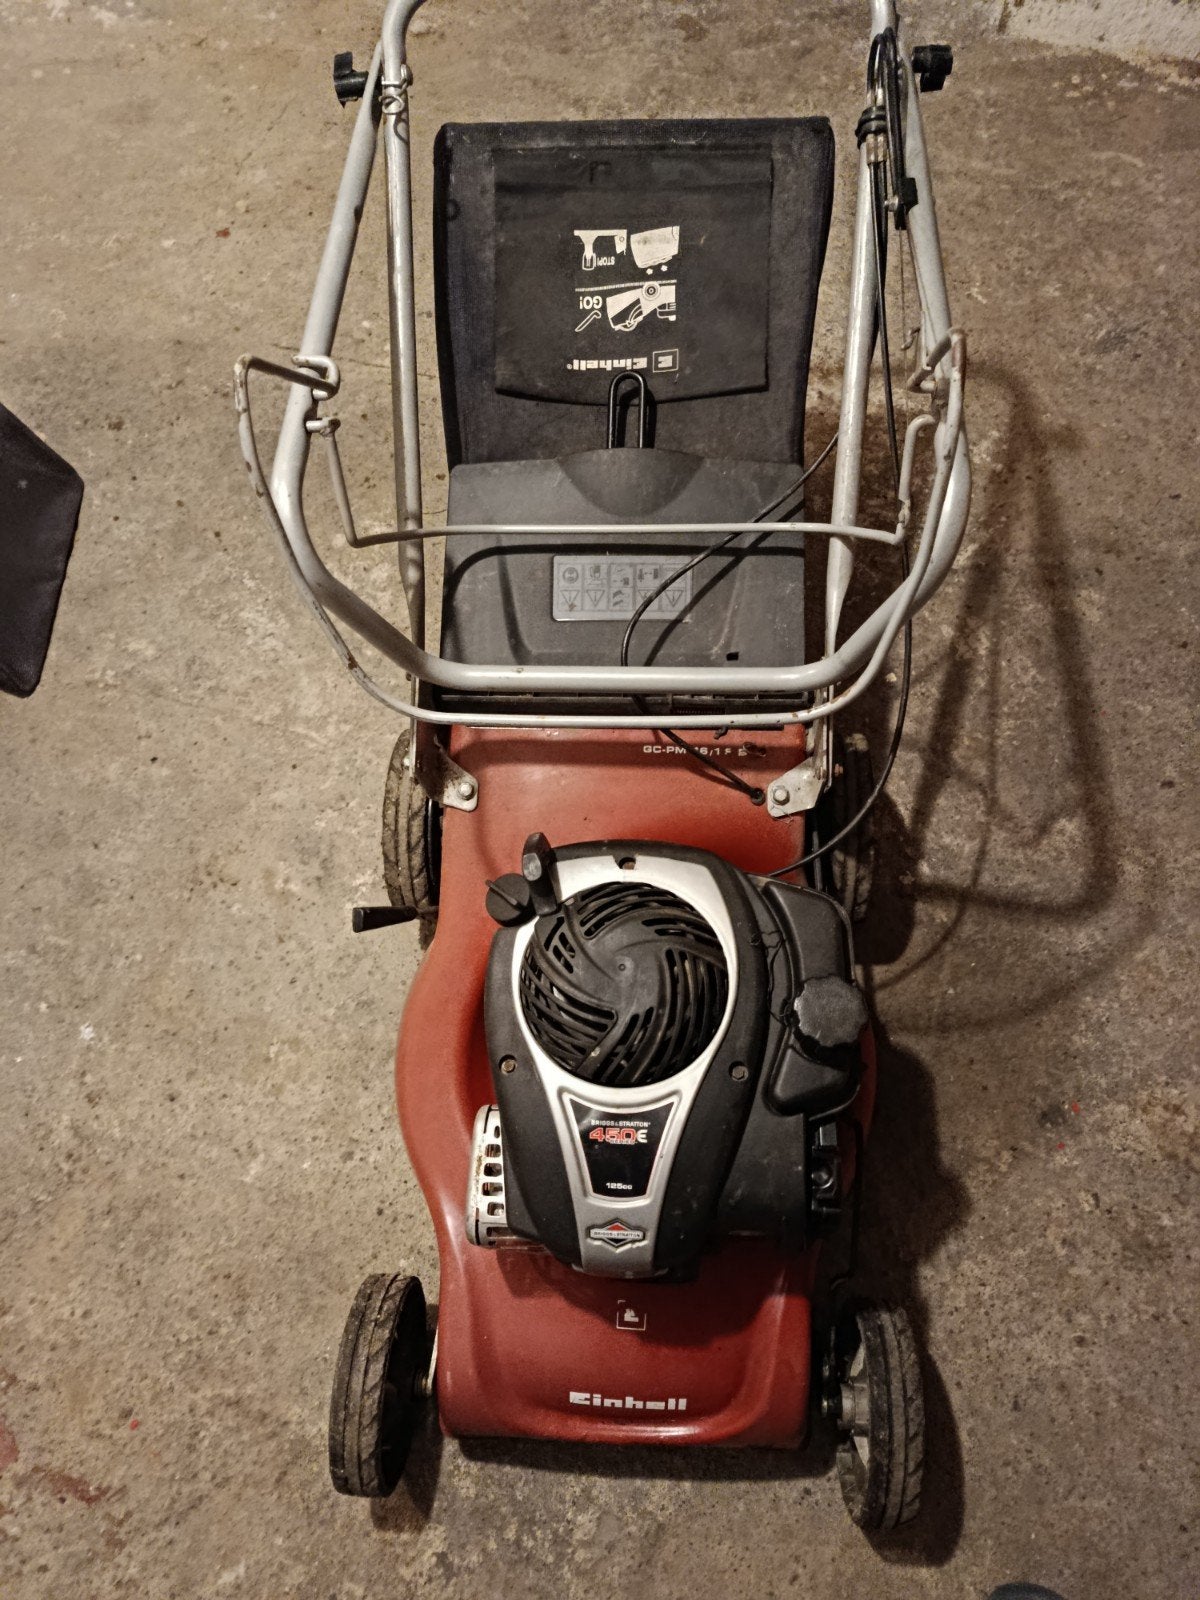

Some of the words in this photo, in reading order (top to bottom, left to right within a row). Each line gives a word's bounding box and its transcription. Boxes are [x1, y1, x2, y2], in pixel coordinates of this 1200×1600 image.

[579, 296, 603, 309] GO!
[643, 745, 687, 755] GC-PM
[569, 1391, 687, 1411] Einhell
